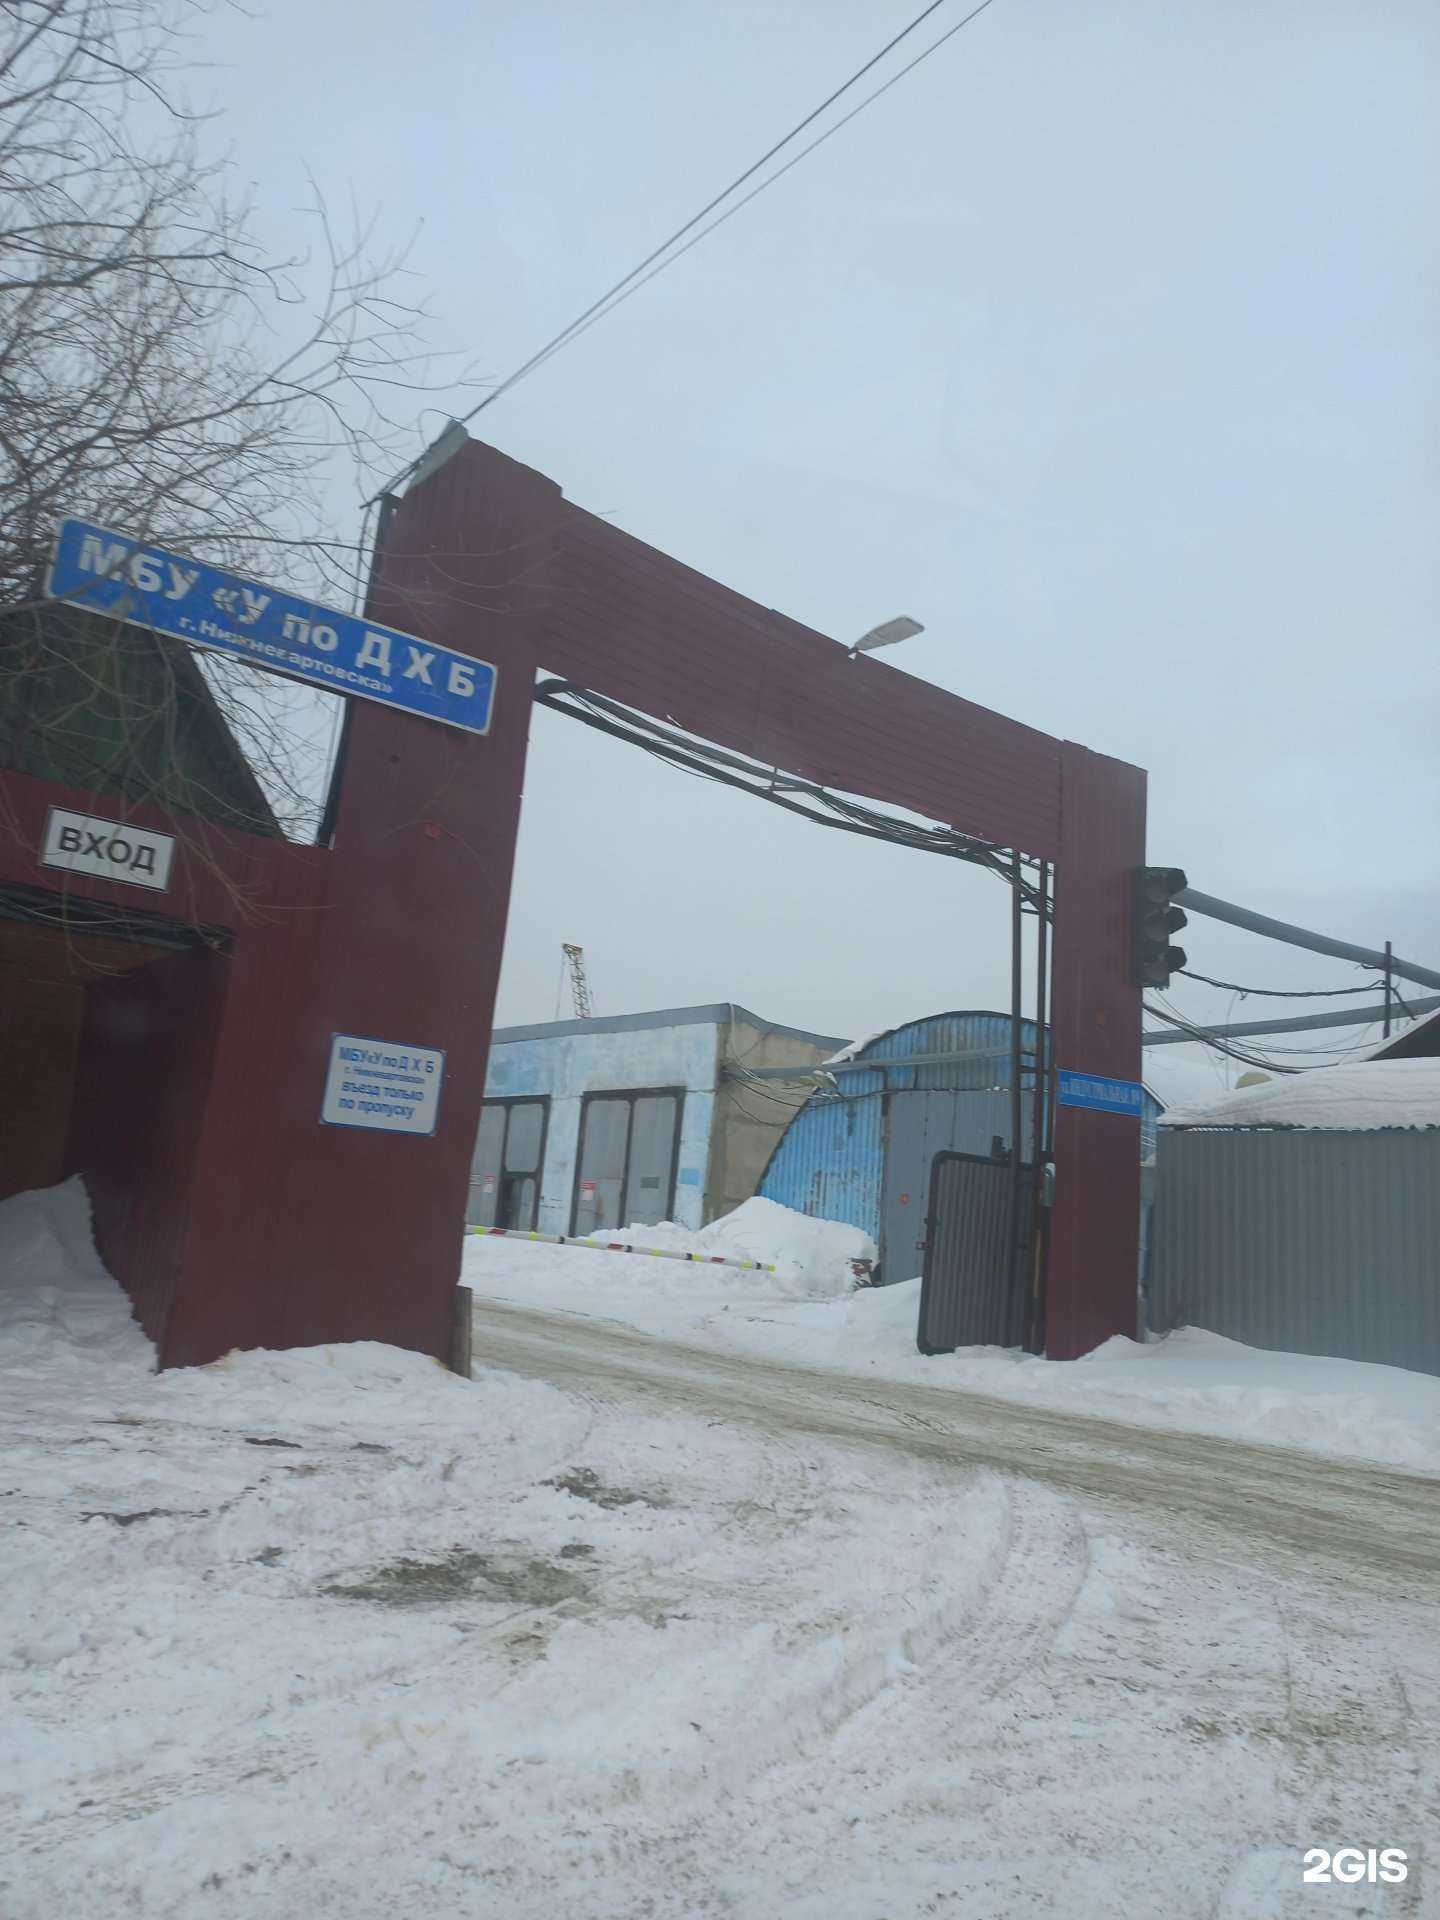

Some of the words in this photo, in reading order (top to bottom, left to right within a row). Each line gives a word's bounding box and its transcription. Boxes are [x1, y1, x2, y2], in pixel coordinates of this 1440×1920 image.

[78, 534, 199, 601] МБУ
[282, 614, 338, 652] по
[355, 631, 391, 676] Д
[401, 648, 436, 685] Х
[447, 661, 477, 698] Б
[59, 826, 155, 875] ВХОД
[337, 1098, 355, 1109] по
